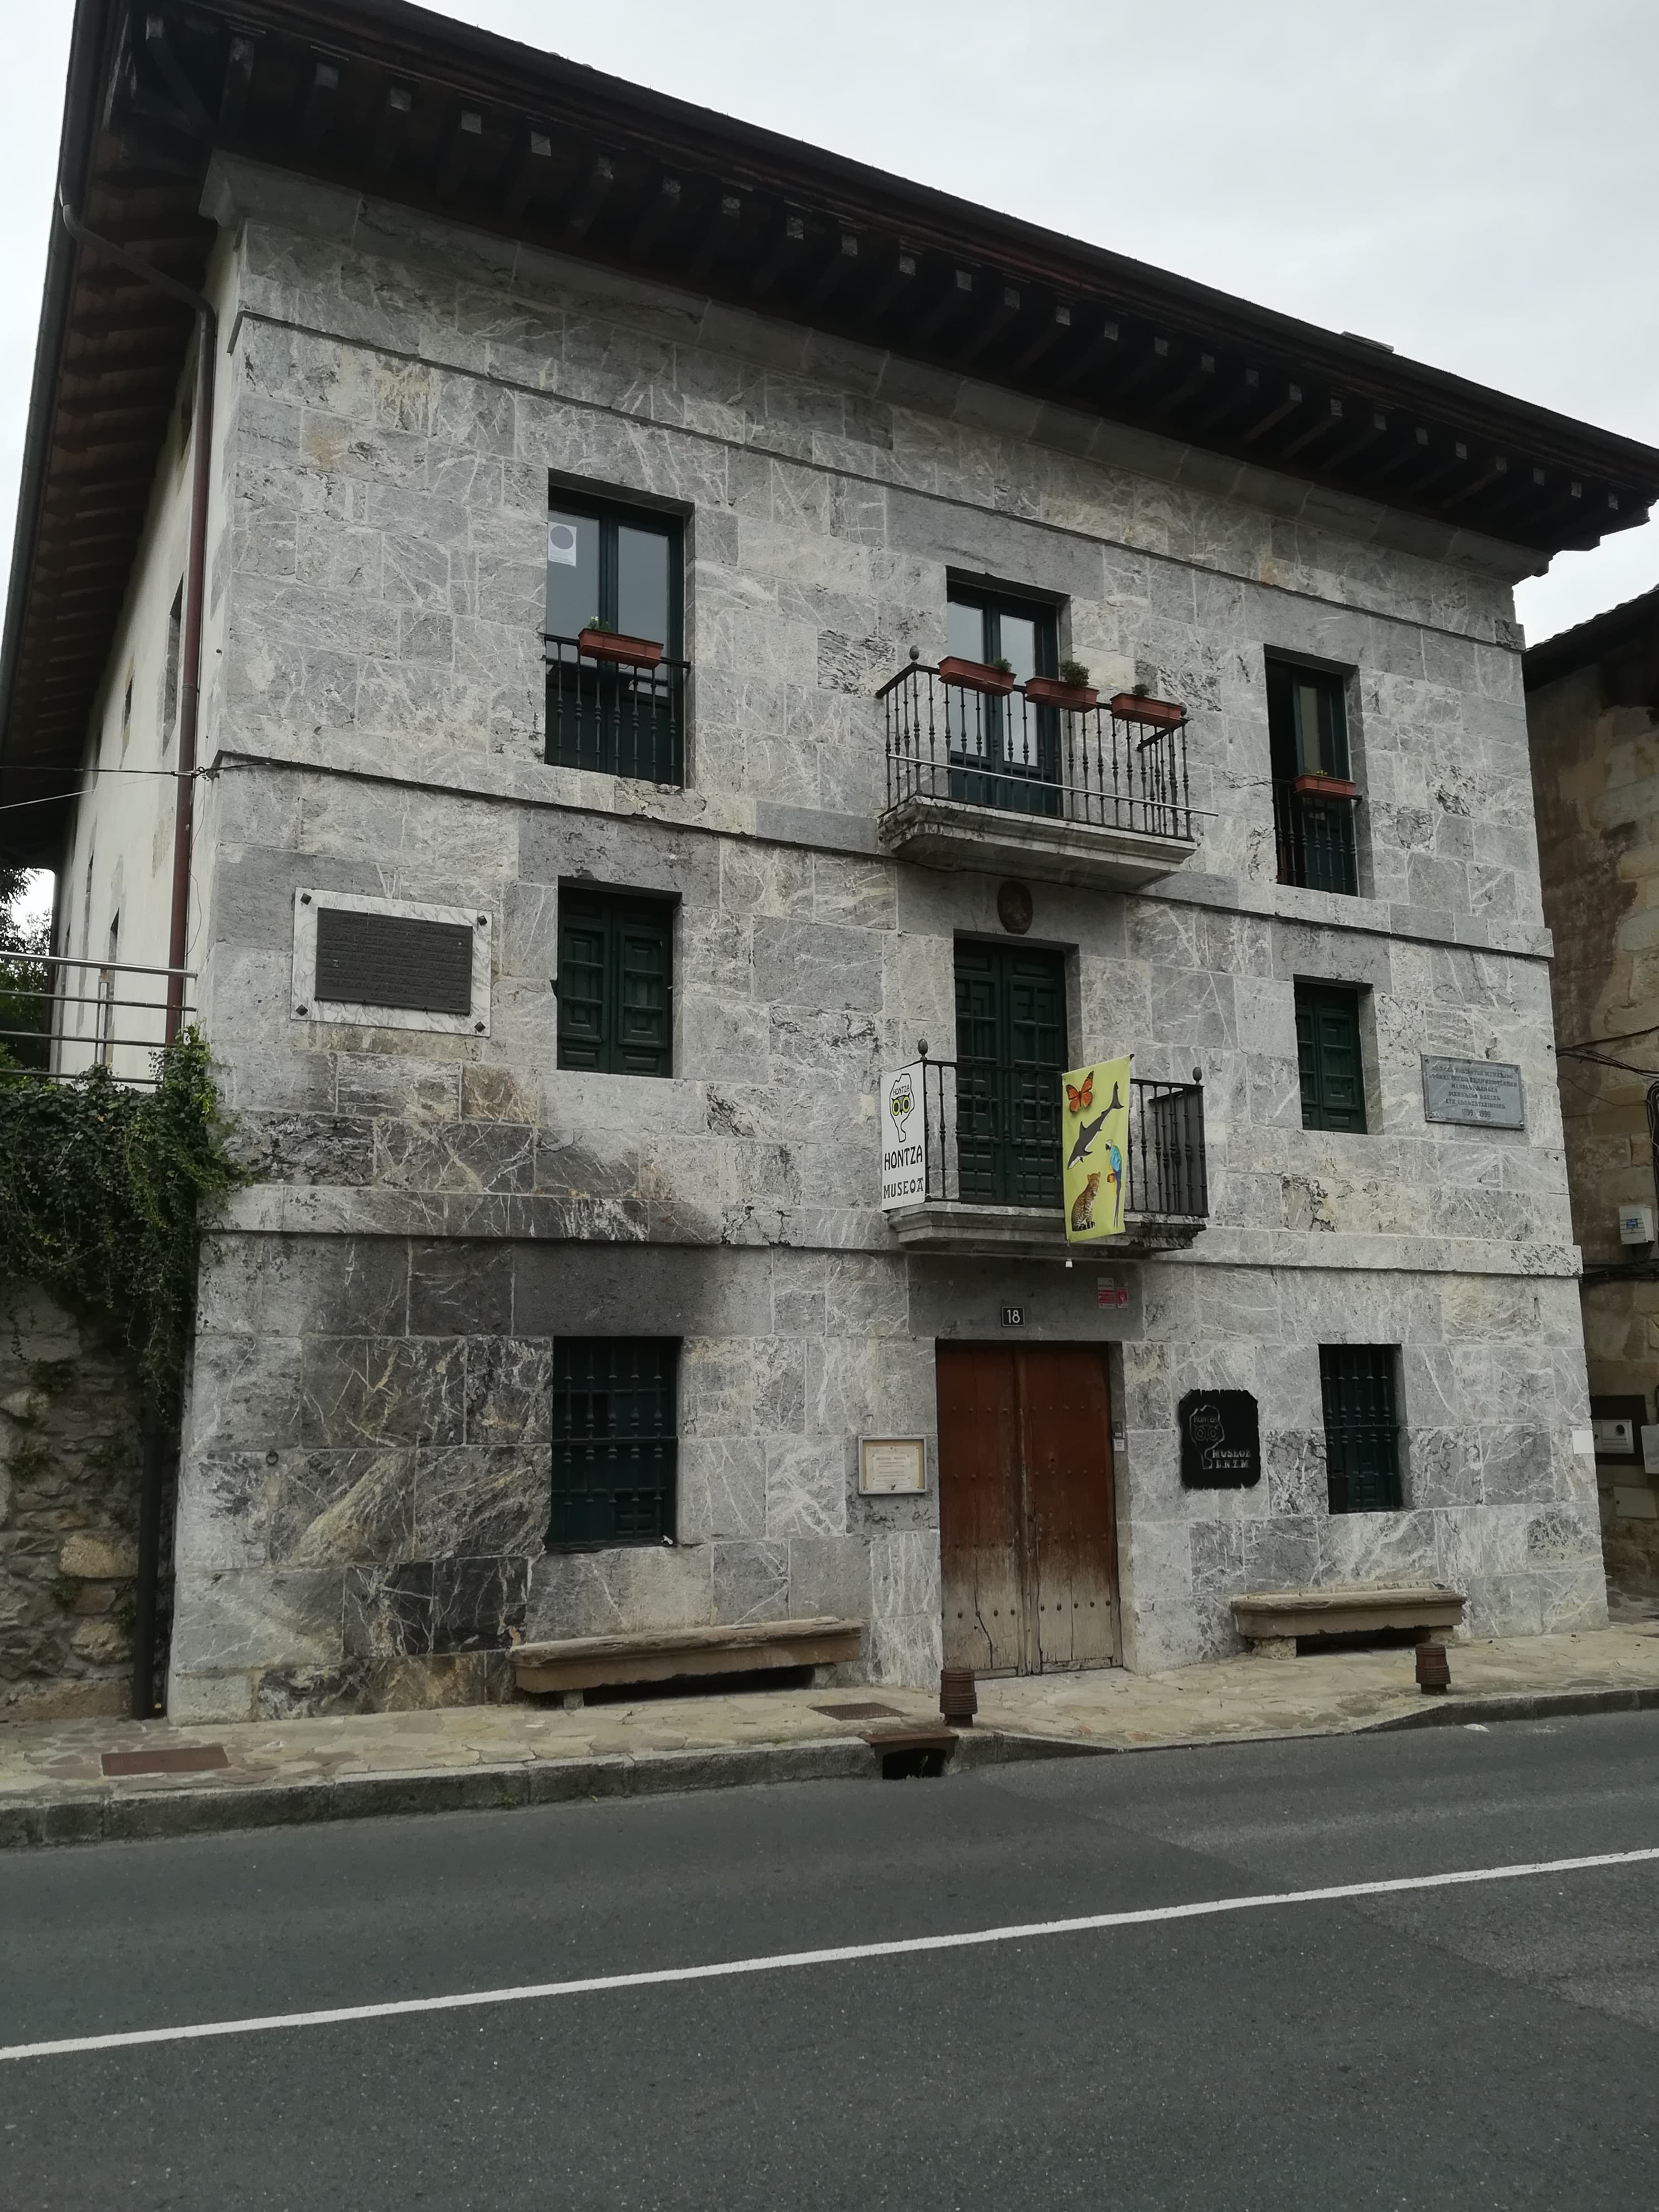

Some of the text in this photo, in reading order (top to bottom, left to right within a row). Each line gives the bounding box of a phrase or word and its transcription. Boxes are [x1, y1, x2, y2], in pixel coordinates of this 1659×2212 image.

[892, 1084, 910, 1096] HONTZA
[884, 1144, 923, 1171] HONTZA
[883, 1177, 924, 1199] MUSEOA
[1007, 1309, 1020, 1323] 18
